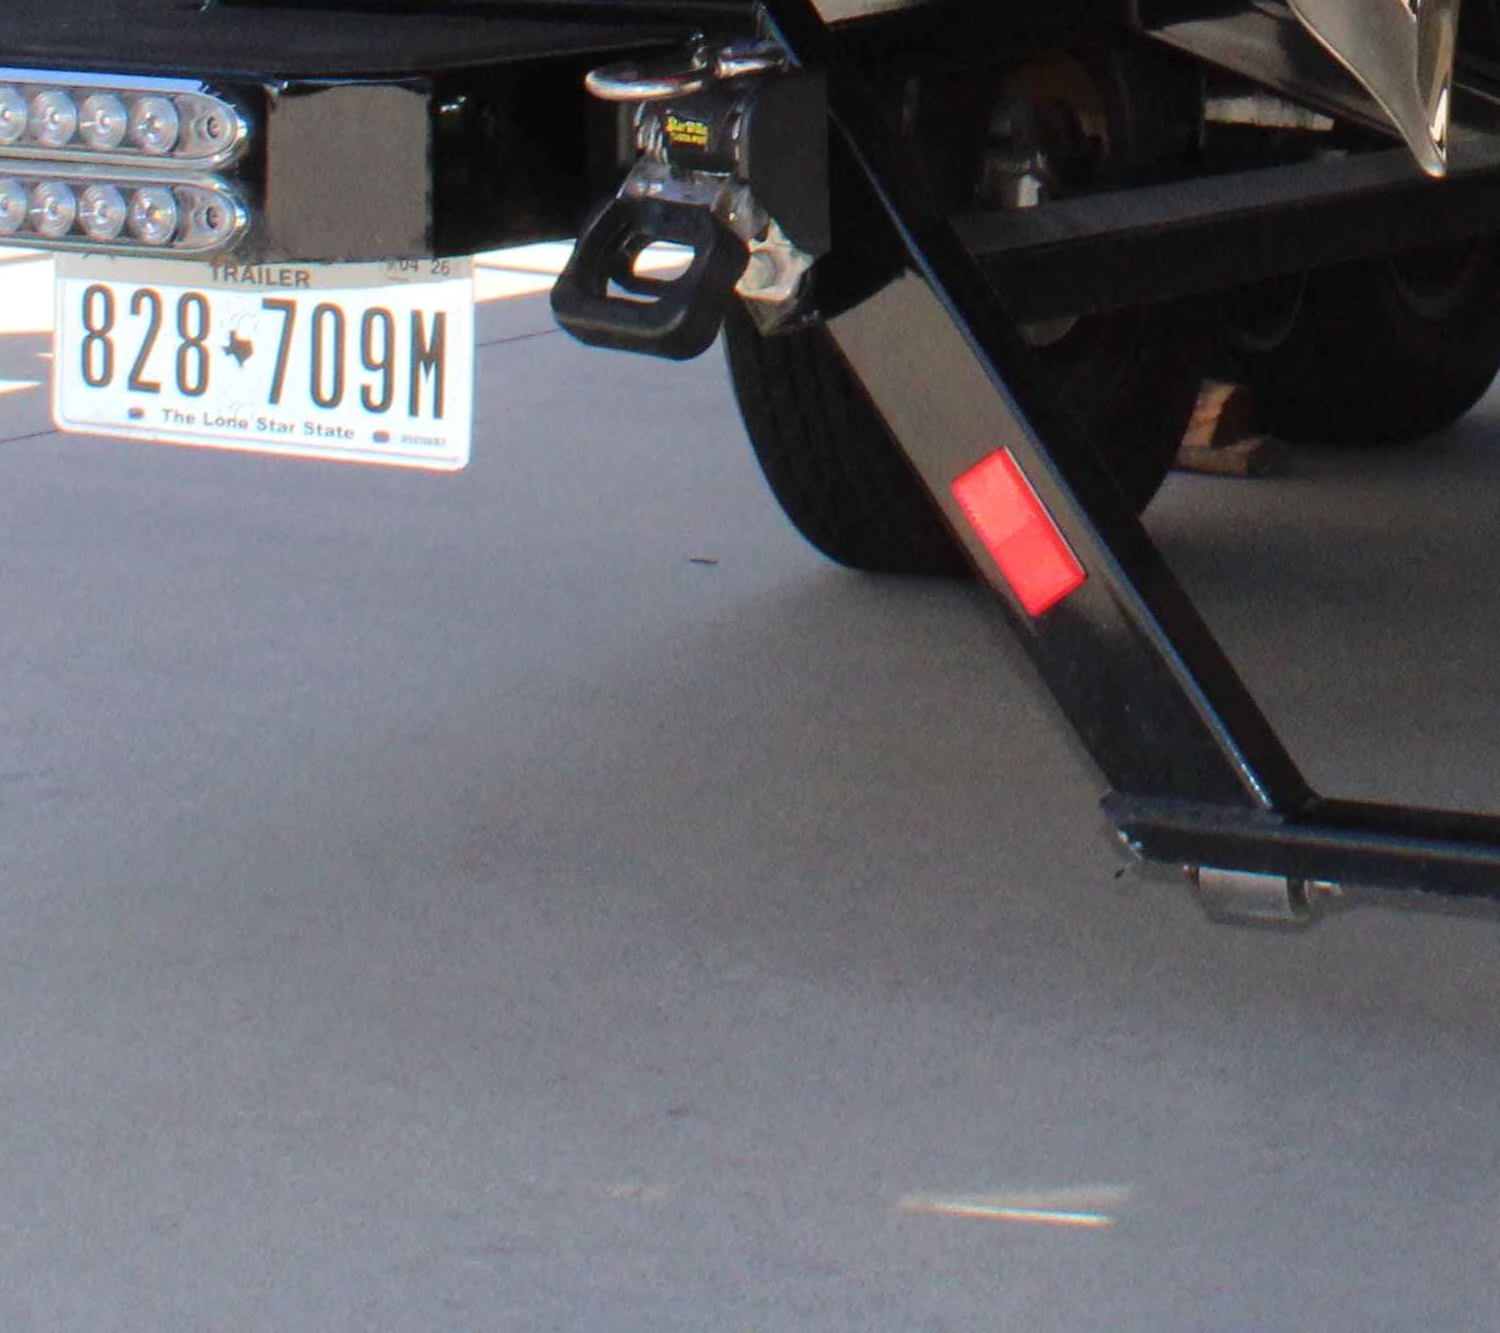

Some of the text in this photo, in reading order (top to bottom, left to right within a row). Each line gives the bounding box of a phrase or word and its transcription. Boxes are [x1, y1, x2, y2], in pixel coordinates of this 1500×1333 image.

[209, 259, 312, 289] TRAILER
[81, 283, 448, 421] 828 709M
[160, 407, 357, 441] The Lone Star State
